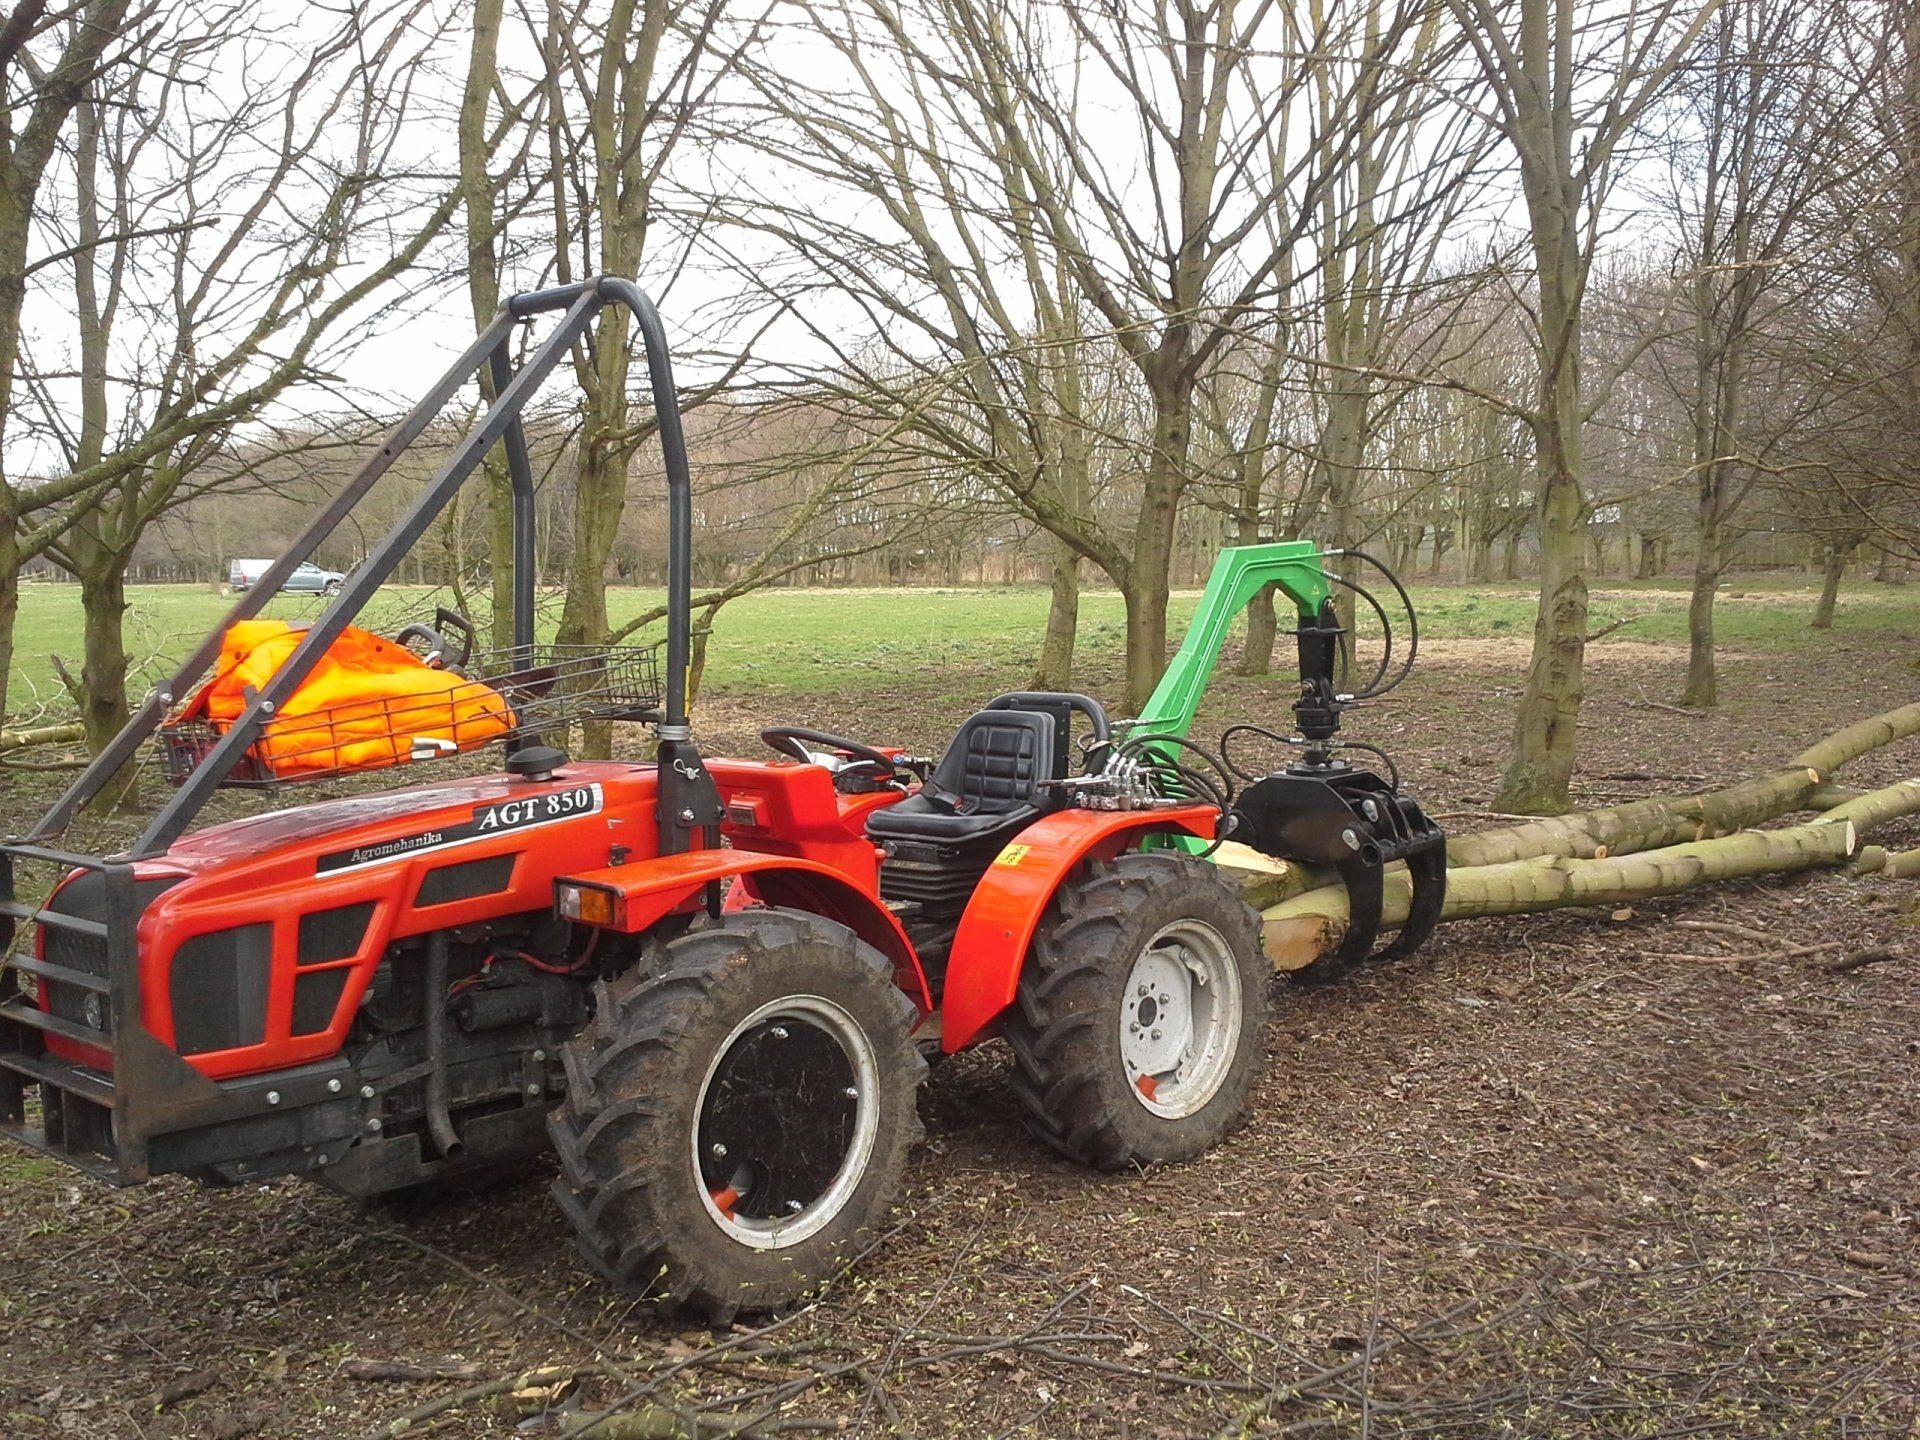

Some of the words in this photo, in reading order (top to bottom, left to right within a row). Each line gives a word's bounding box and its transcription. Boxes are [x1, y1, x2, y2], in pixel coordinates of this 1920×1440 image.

[478, 799, 539, 830] AGT
[547, 789, 588, 815] 850
[351, 832, 443, 862] Agromehanika
